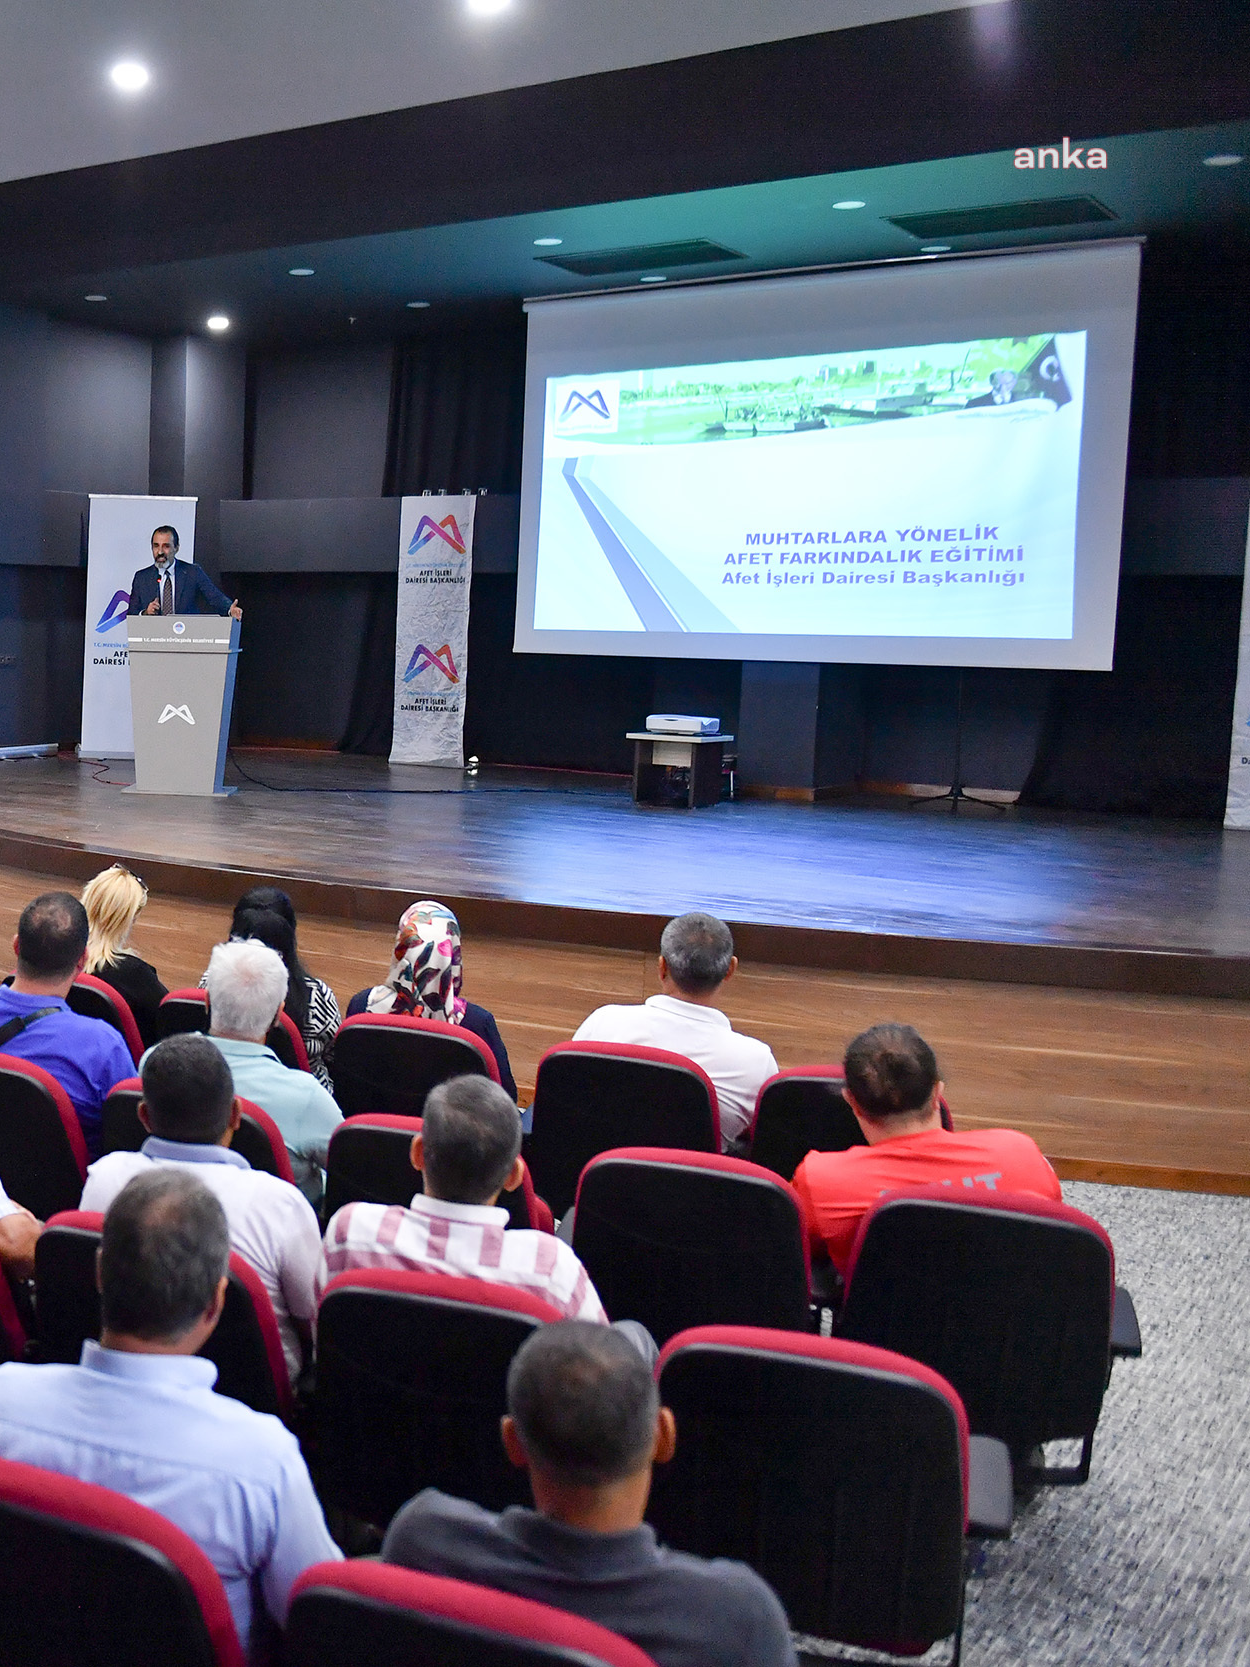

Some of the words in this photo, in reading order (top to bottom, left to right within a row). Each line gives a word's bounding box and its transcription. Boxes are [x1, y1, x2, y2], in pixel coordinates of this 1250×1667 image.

[745, 530, 888, 546] MUHTARLARA
[895, 523, 999, 542] YÖNELİK
[723, 552, 774, 566] AFET
[779, 550, 923, 565] FARKINDALIK
[930, 544, 1024, 563] EĞİTİMİ
[721, 572, 761, 585] Afet
[766, 569, 815, 588] İşleri
[822, 570, 896, 585] Dairesi
[902, 569, 1025, 588] Başkanlığı
[93, 657, 126, 666] DAİRESİ
[113, 650, 128, 658] AFE
